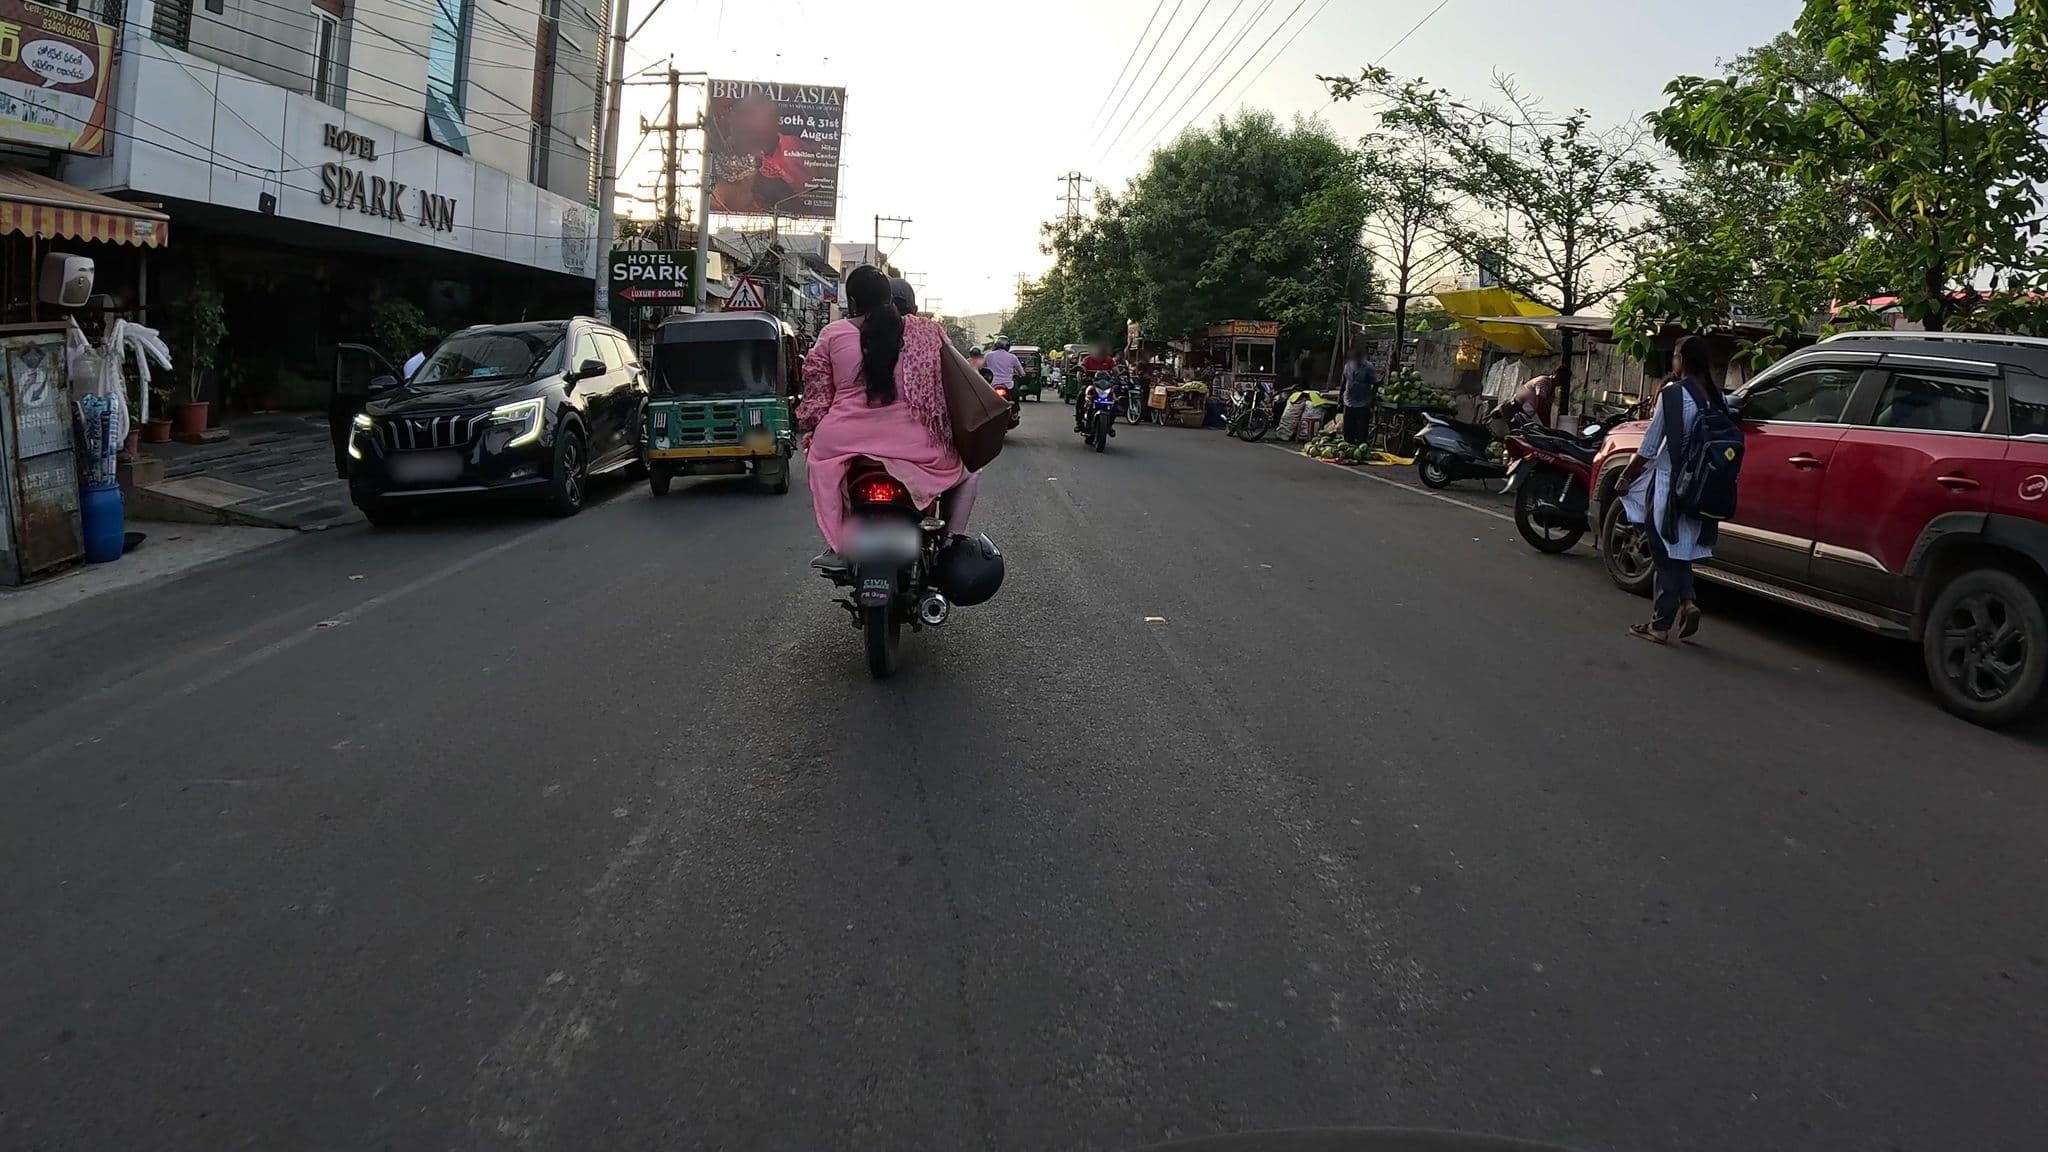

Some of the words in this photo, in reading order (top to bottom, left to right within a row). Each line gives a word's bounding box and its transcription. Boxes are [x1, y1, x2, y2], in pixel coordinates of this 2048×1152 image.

[42, 18, 66, 34] 83400
[66, 25, 90, 41] 60606
[712, 80, 790, 102] BRIDAL
[794, 86, 841, 106] ASIA
[778, 115, 804, 125] 30th
[807, 116, 815, 126] &
[818, 118, 840, 128] 31st
[324, 123, 378, 161] HOTEL
[800, 128, 838, 142] August
[784, 150, 815, 158] Exhibition
[804, 160, 837, 168] Hyderabad
[320, 162, 407, 222] SPARK
[628, 254, 674, 264] HOTEL
[613, 263, 689, 280] SPARK
[631, 290, 656, 298] LUXURY
[658, 290, 681, 298] ROOMS
